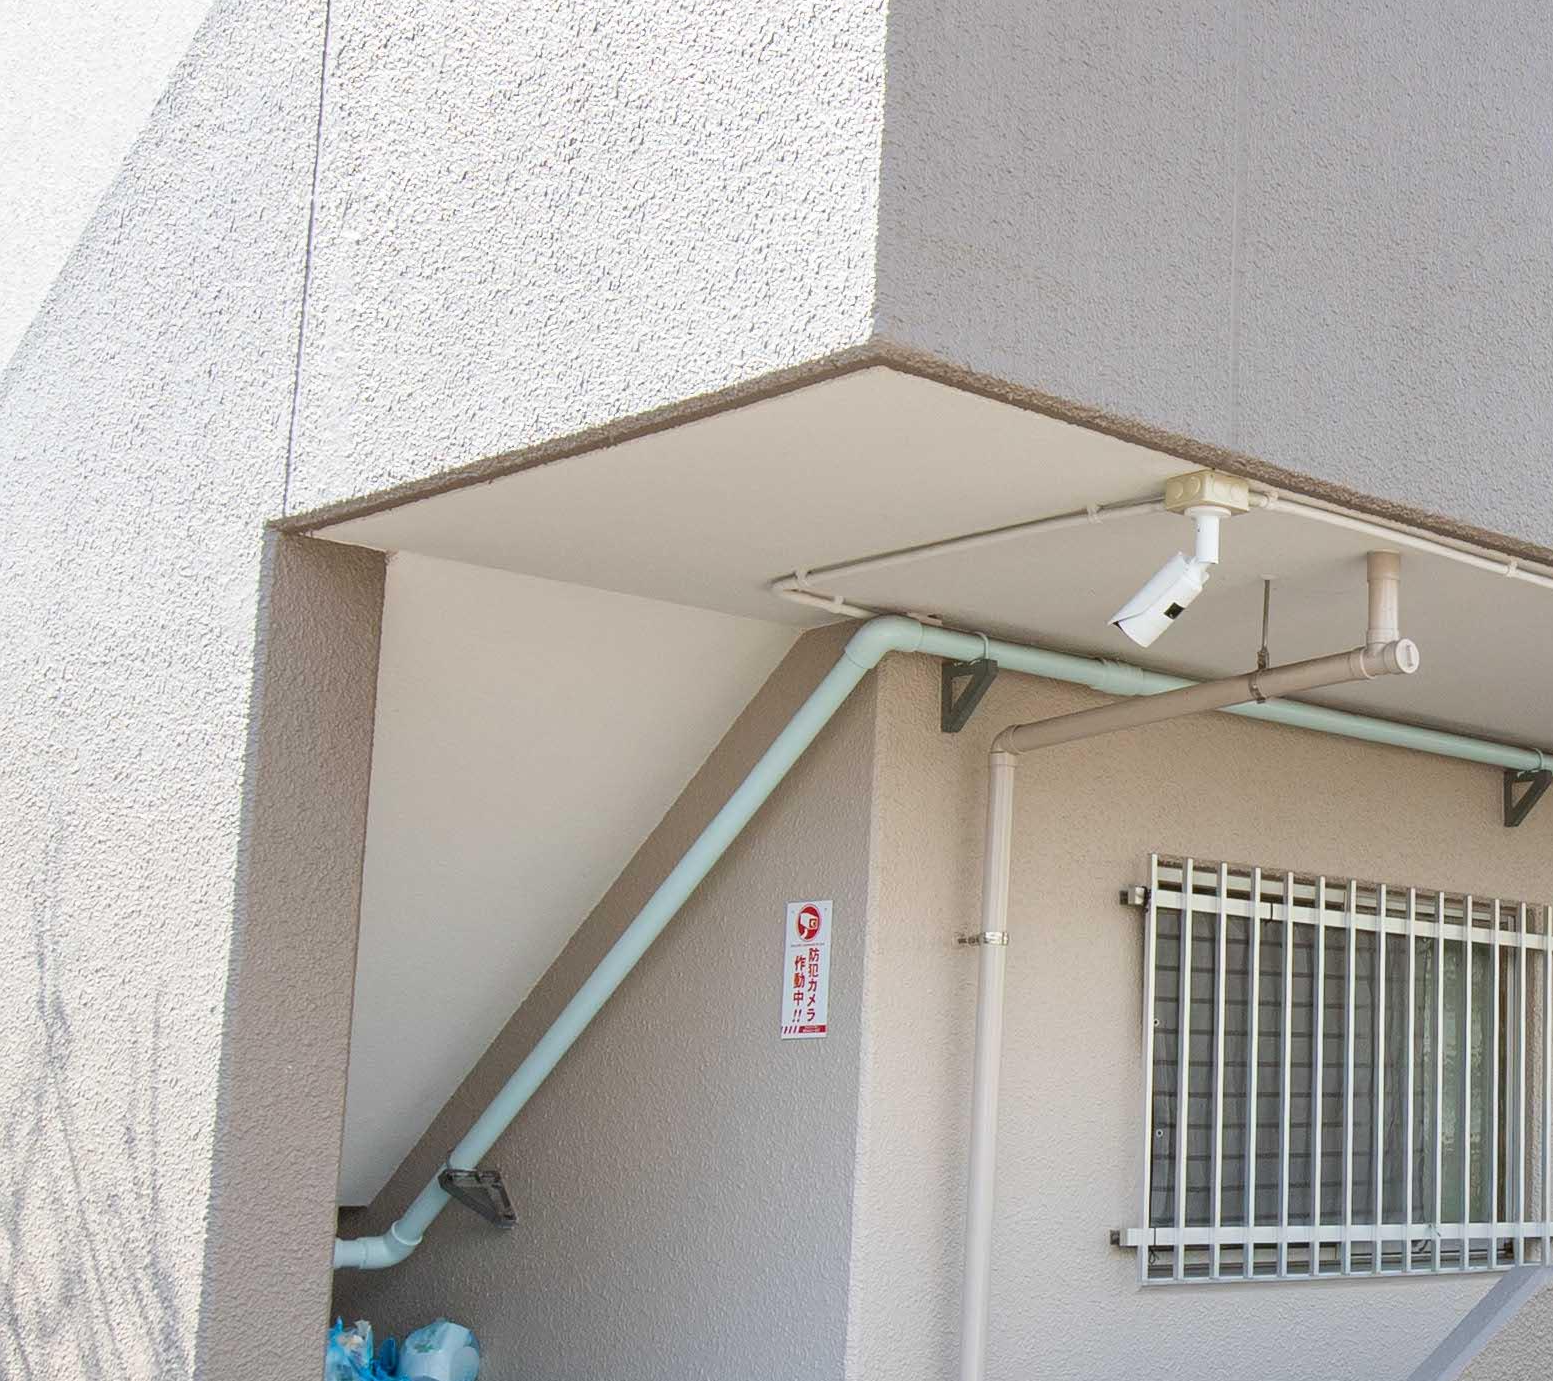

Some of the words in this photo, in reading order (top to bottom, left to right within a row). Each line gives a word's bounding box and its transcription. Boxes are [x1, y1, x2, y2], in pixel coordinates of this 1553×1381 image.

[807, 948, 820, 1021] 防犯カメラ
